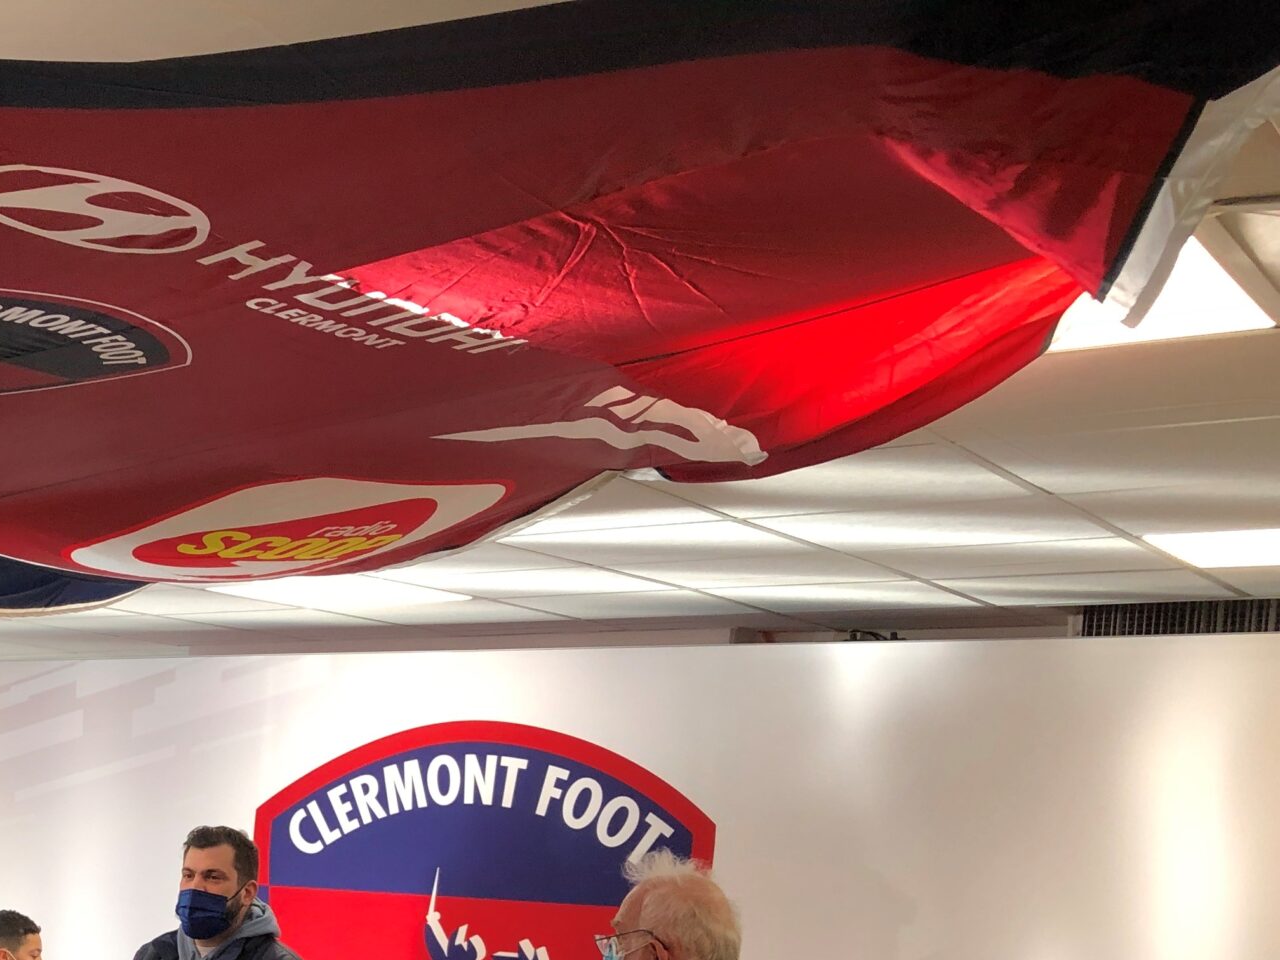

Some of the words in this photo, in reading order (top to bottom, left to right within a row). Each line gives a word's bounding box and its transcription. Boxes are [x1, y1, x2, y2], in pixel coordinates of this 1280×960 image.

[245, 297, 407, 349] CLERMONT
[90, 333, 148, 366] FOOT
[307, 520, 398, 538] radio
[288, 753, 529, 855] CLERMONT
[535, 764, 675, 866] FOOT
